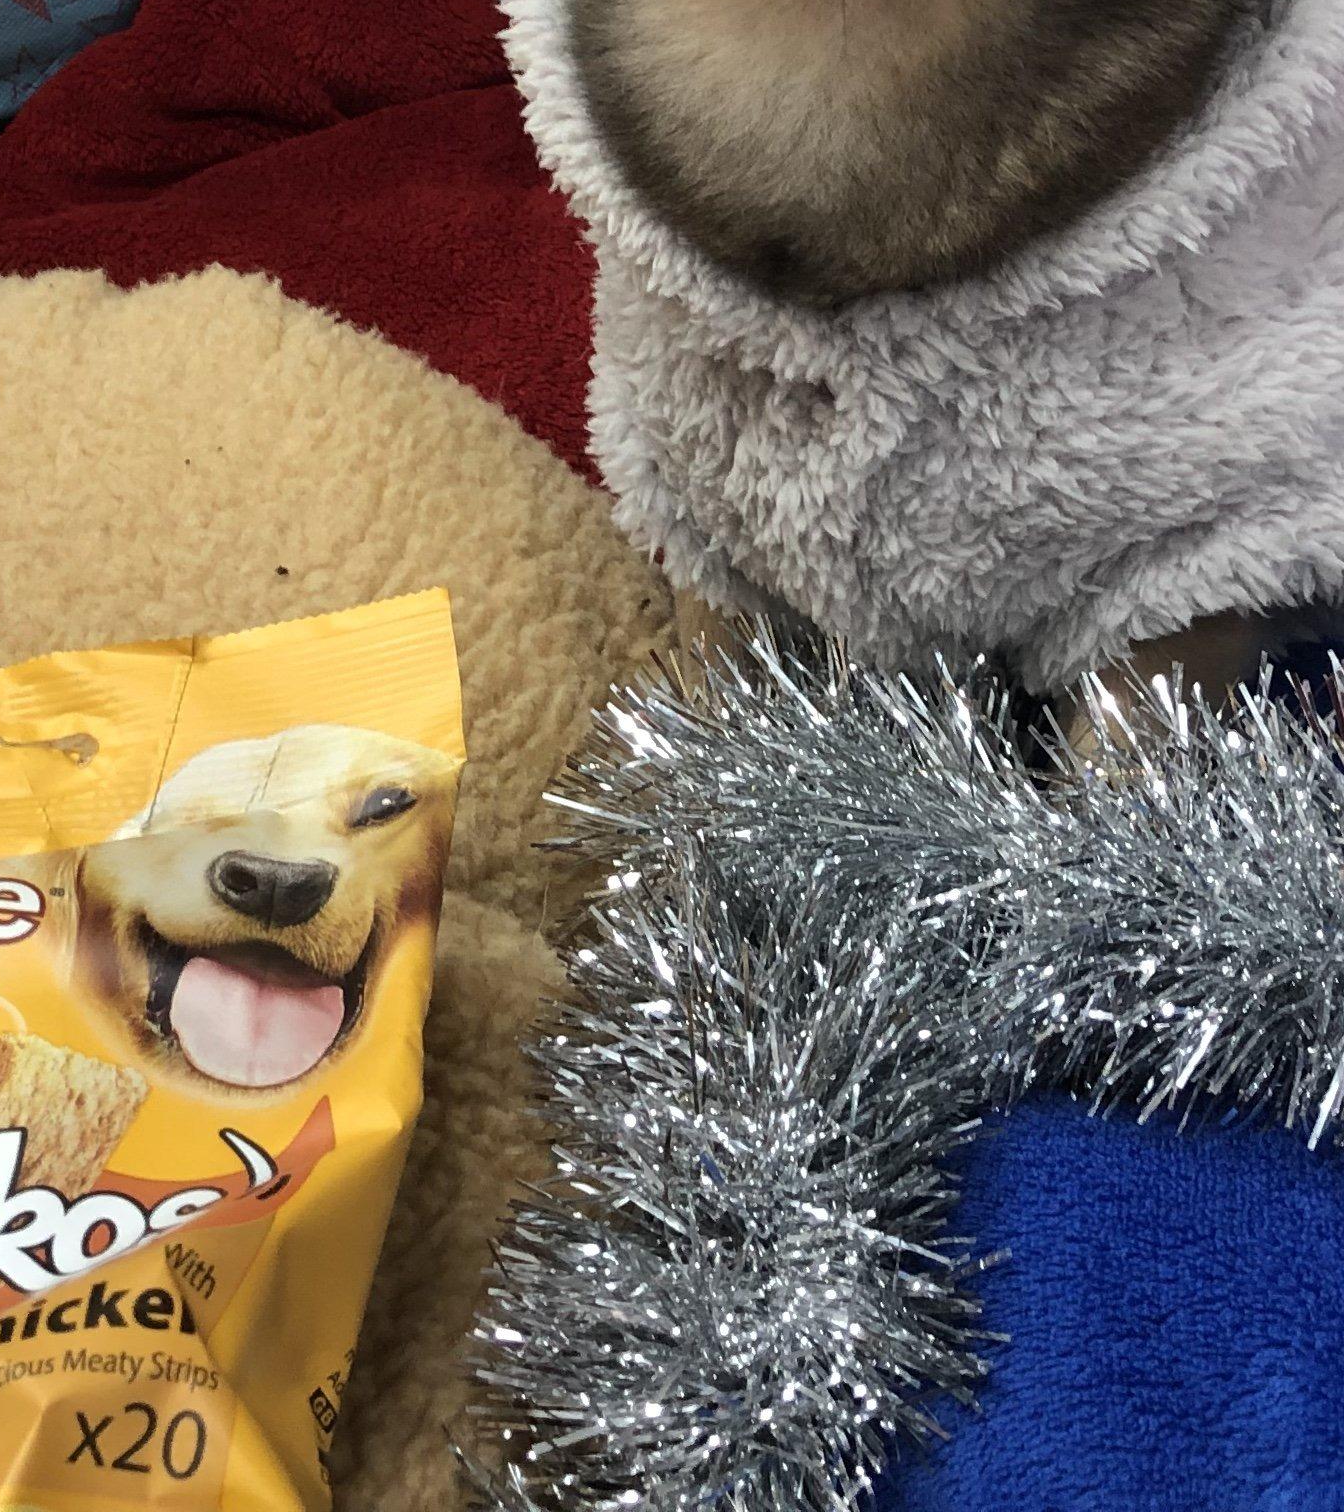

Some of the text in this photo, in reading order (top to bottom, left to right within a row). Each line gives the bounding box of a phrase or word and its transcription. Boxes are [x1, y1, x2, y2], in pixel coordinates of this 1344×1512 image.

[62, 1347, 144, 1384] Meaty
[150, 1351, 220, 1392] Strips
[65, 1401, 208, 1481] x20
